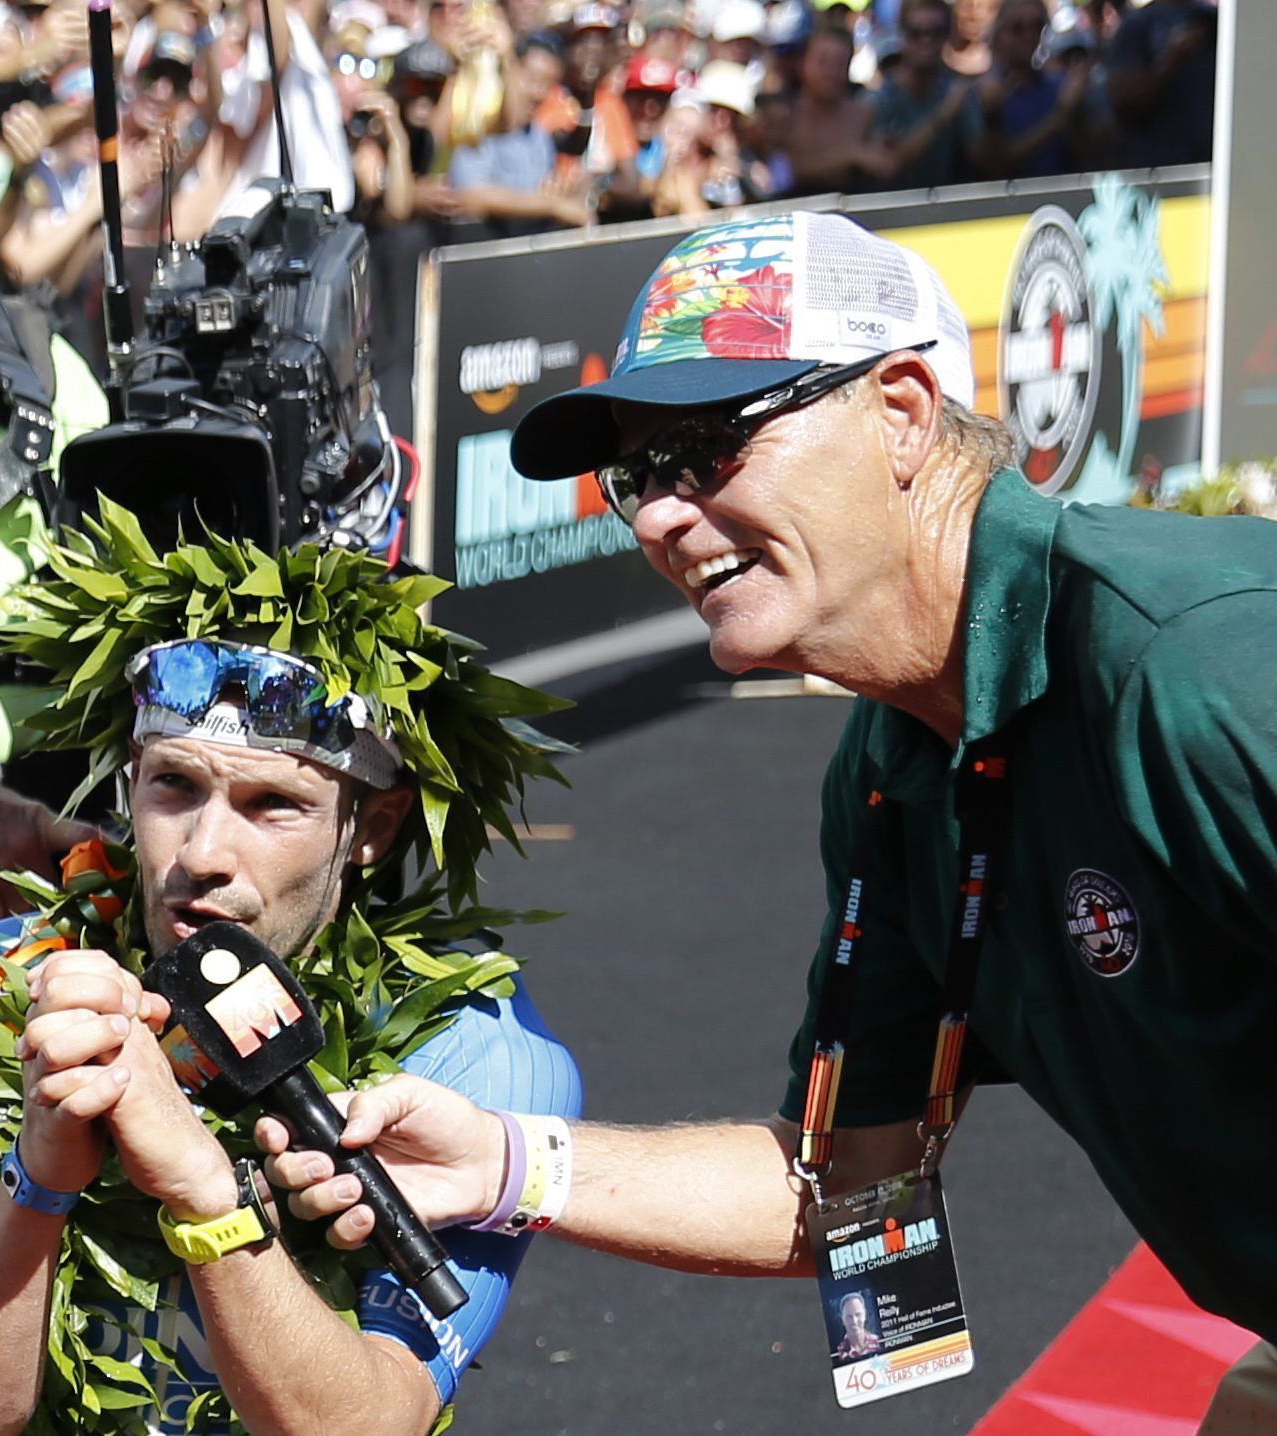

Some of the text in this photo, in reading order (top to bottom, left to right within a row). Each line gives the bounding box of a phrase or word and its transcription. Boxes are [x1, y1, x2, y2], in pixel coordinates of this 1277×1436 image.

[459, 336, 541, 394] amazon
[455, 532, 535, 591] WORLD
[185, 713, 249, 737] sailfish
[960, 855, 987, 938] IRONMAN
[836, 878, 862, 965] IRONMAN
[826, 1222, 860, 1241] amazon
[829, 1217, 939, 1272] IRONMAN
[832, 1241, 938, 1281] WORLD CHAMPIONSHIP
[845, 1366, 877, 1393] 40
[886, 1353, 967, 1385] YEARS OF DREAMS
